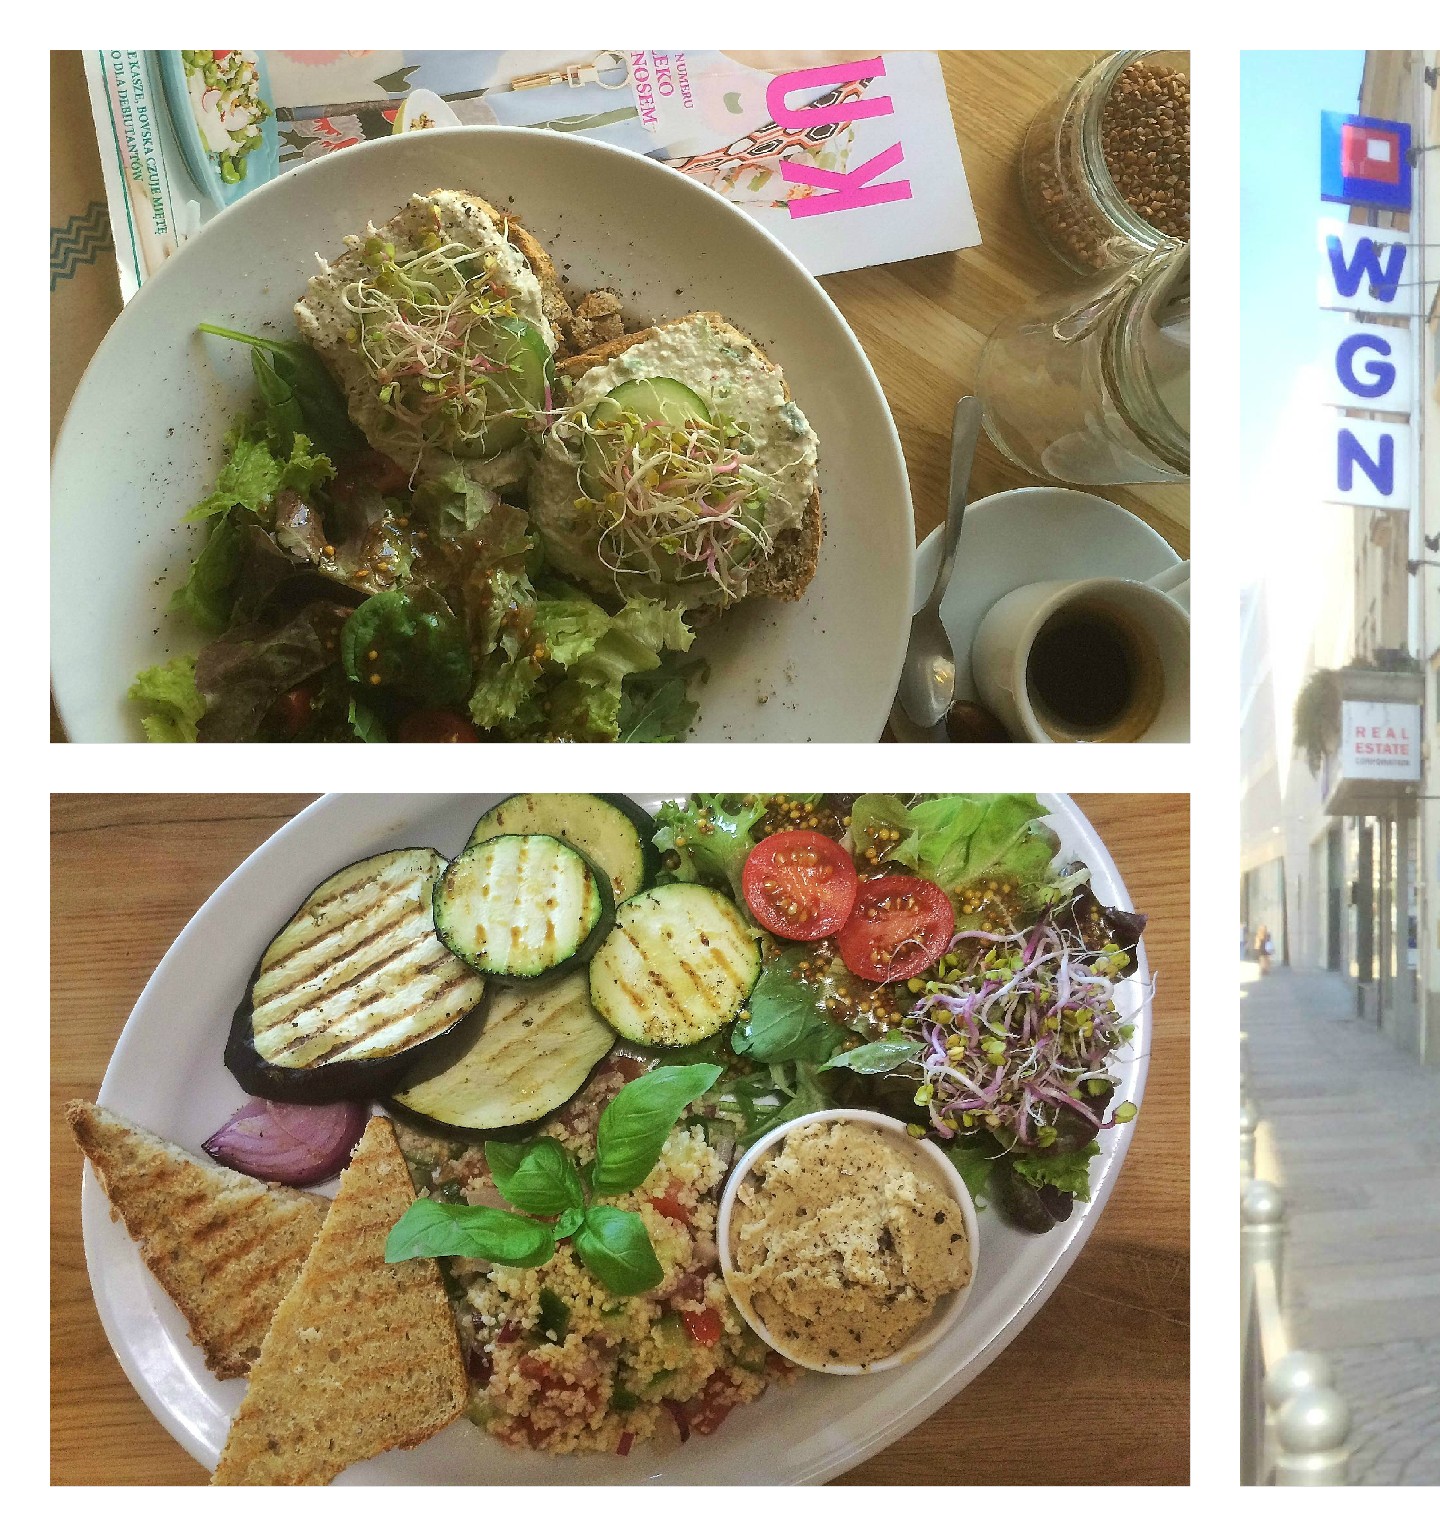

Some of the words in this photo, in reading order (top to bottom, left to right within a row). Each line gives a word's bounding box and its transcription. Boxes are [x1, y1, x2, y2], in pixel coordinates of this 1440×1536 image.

[114, 63, 126, 87] DLA
[129, 61, 143, 103] KASZE,
[631, 51, 658, 125] NOSEM
[675, 53, 694, 109] NUMERU
[118, 90, 143, 182] DEBIUTANTÓW
[137, 105, 153, 155] BOVSKA
[147, 158, 161, 193] CZUJE
[152, 197, 168, 235] MIĘTĘ
[1326, 233, 1407, 497] WGN
[1355, 726, 1409, 740] REAL
[1355, 742, 1409, 756] ESTATE
